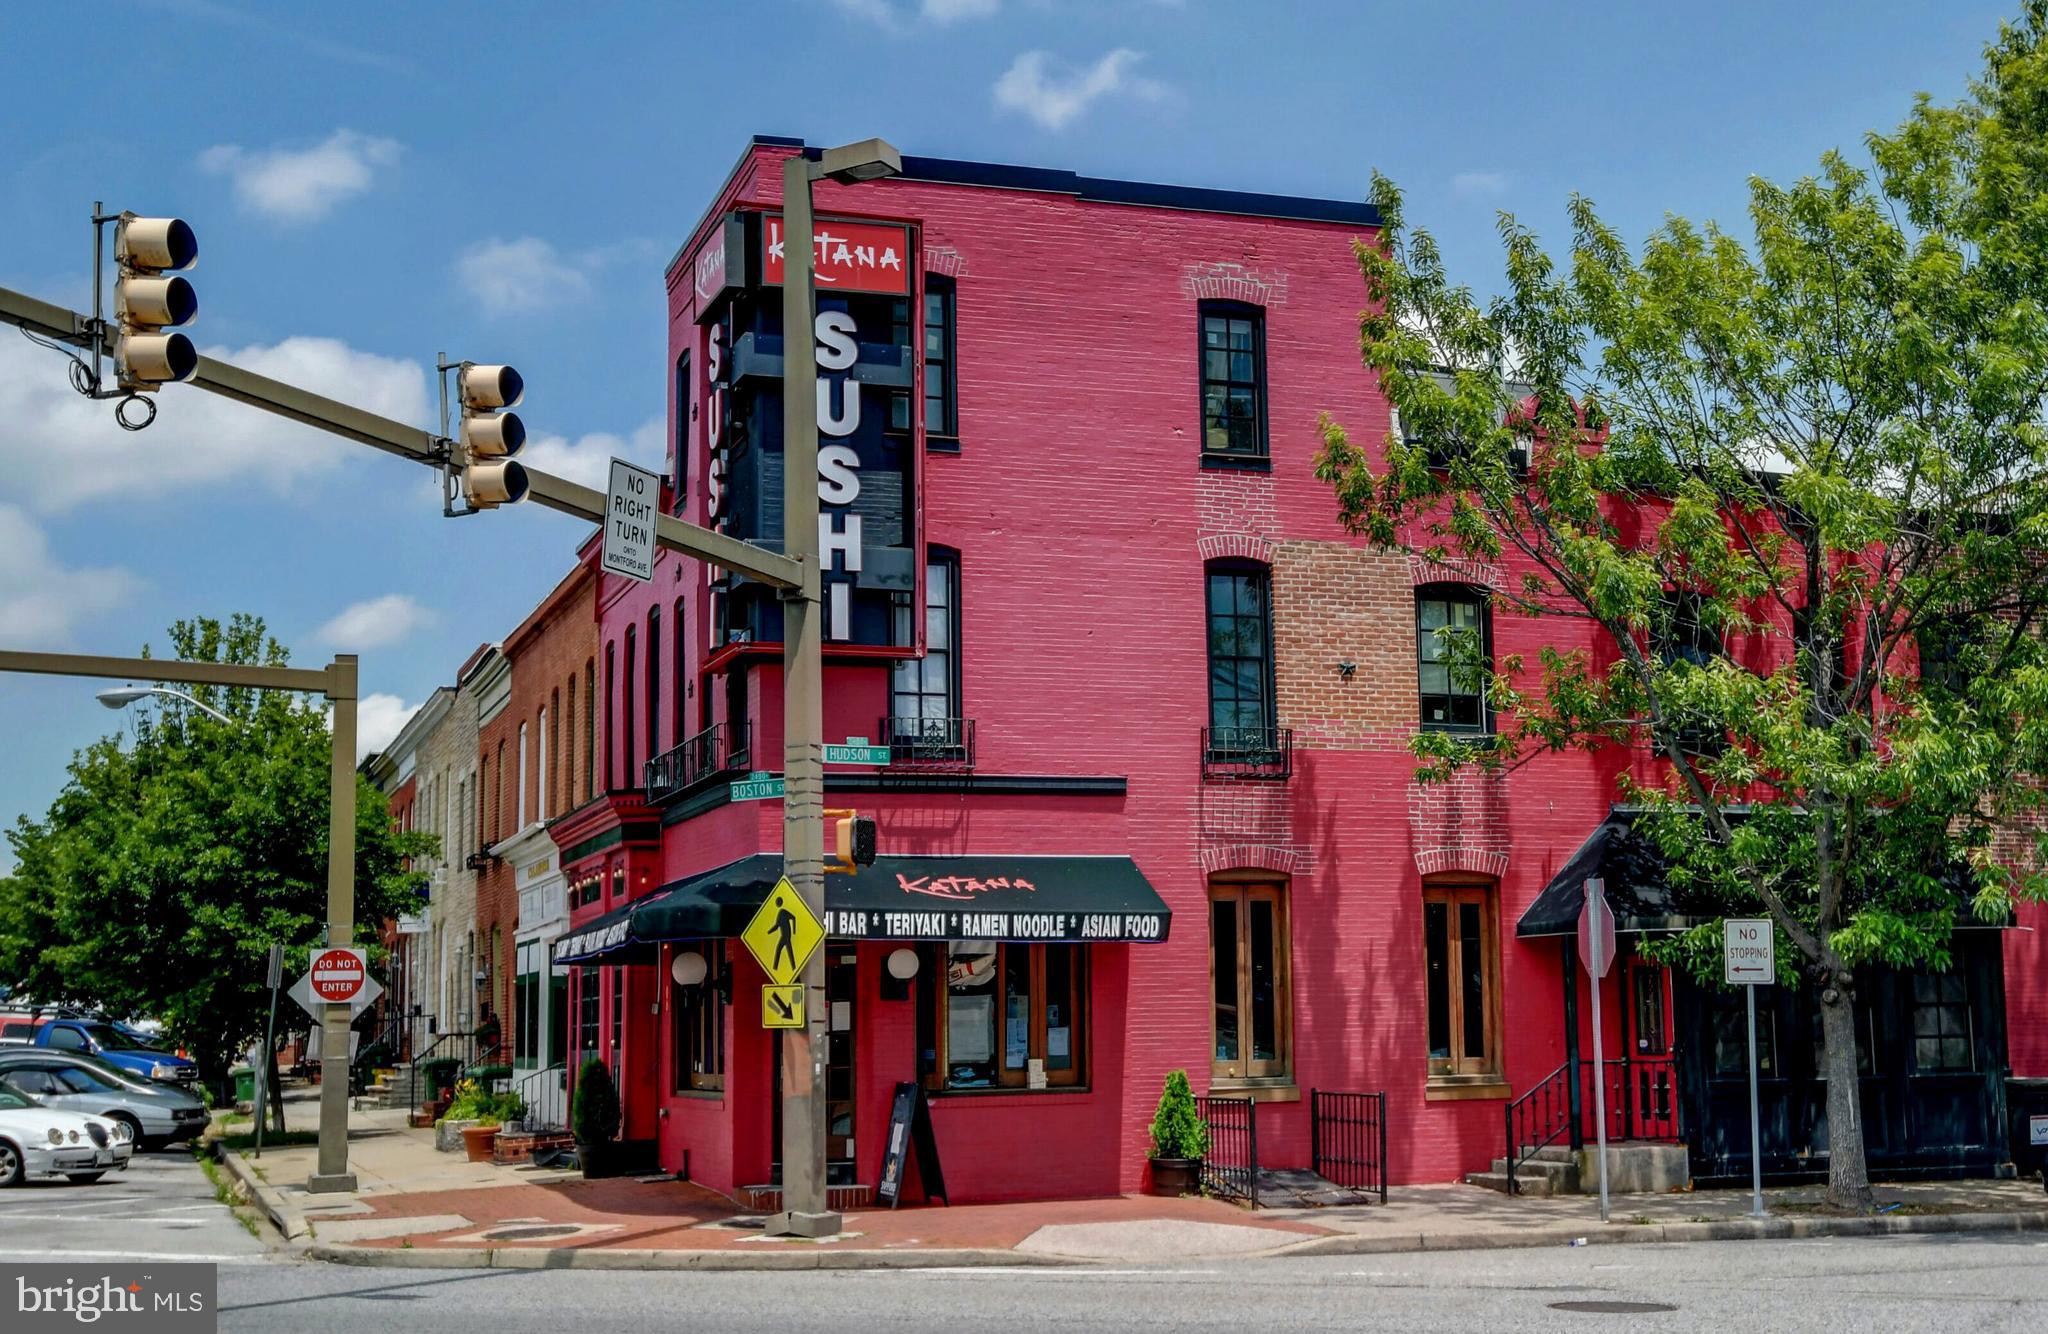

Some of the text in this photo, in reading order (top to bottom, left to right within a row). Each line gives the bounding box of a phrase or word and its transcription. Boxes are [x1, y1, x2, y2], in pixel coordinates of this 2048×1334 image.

[768, 223, 900, 281] KTANA
[815, 311, 861, 641] SUSHI
[627, 474, 644, 495] NO
[615, 496, 651, 522] RIGHT
[616, 520, 647, 546] TURN
[623, 546, 636, 556] ONTO
[608, 552, 637, 569] MONTFORD
[829, 748, 870, 760] HUDSON
[732, 783, 773, 798] BOSTON
[839, 912, 867, 935] BAR
[885, 913, 945, 936] TERIYAKI
[962, 914, 1009, 936] RAMEN
[1013, 915, 1065, 937] NOODLE
[1081, 915, 1121, 937] ASIAN
[1125, 915, 1160, 937] FOOD
[1739, 928, 1758, 940] NO
[1730, 947, 1768, 959] STOPPING
[320, 960, 357, 968] DO NOT
[322, 983, 352, 991] ENTER
